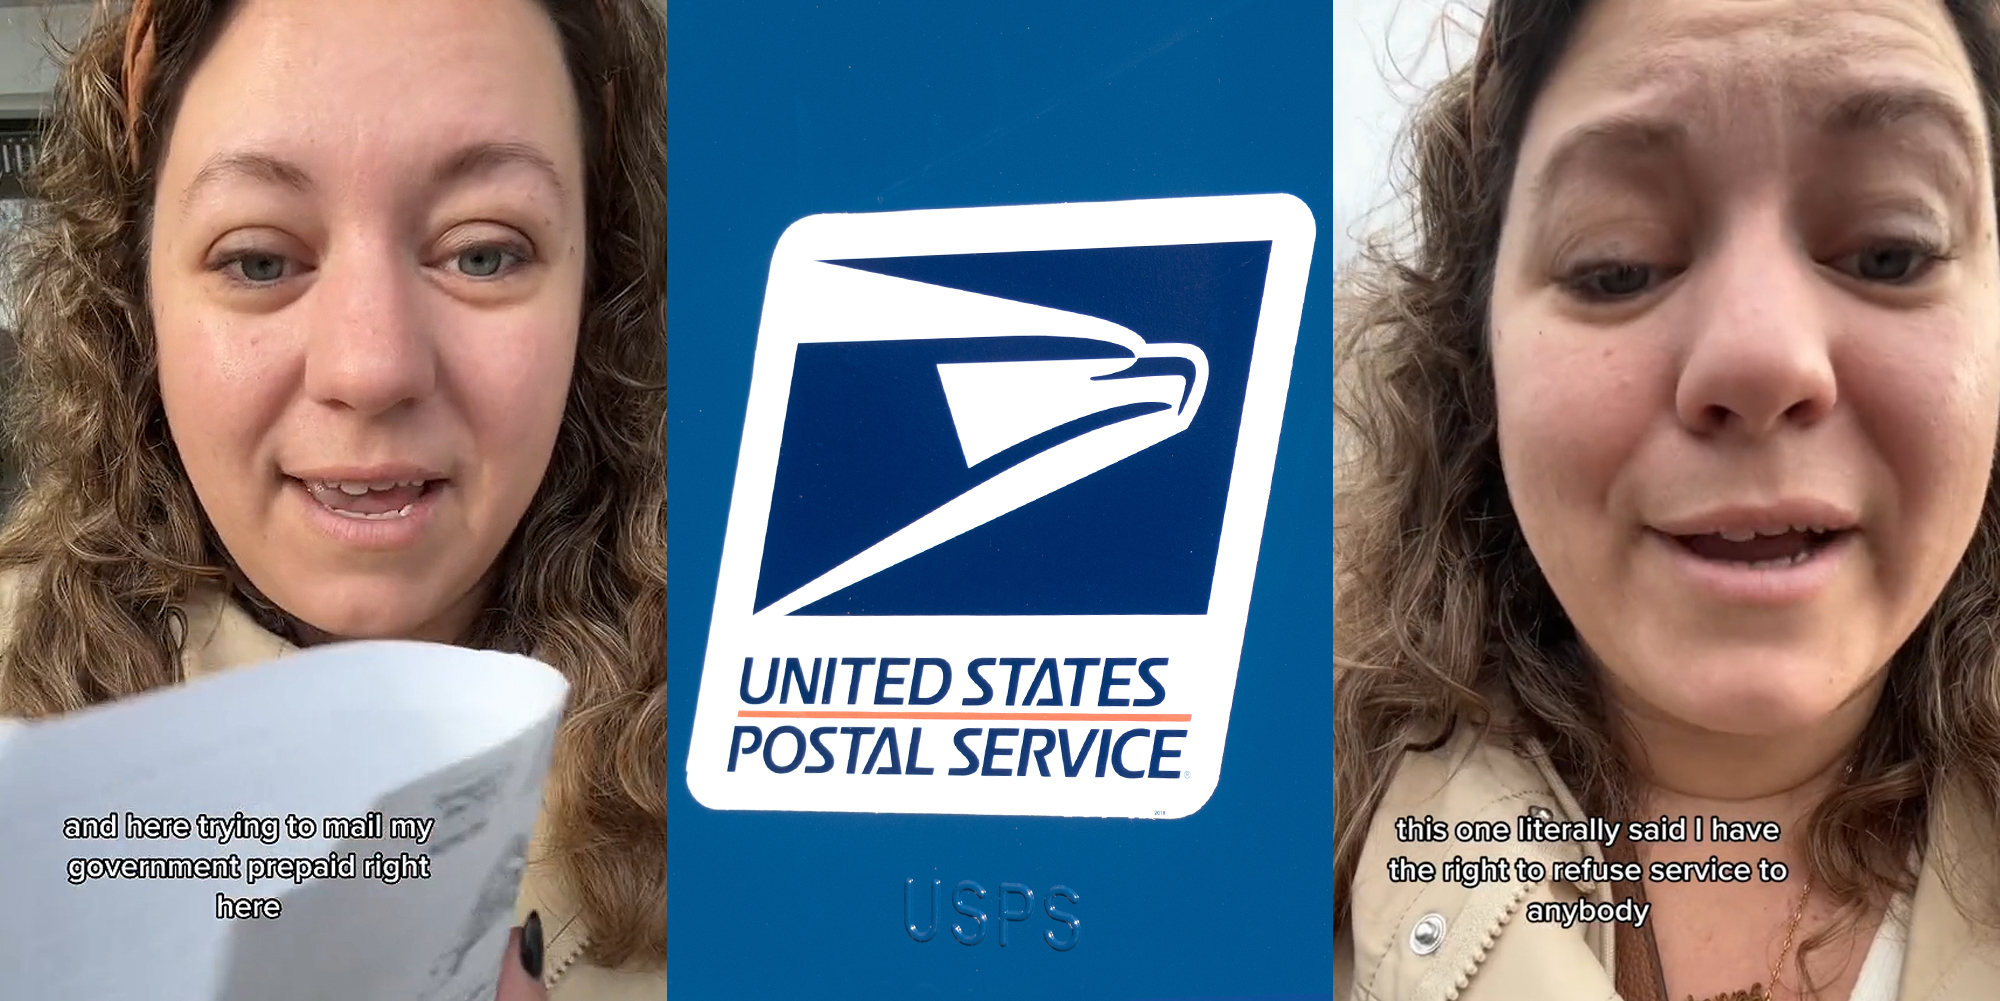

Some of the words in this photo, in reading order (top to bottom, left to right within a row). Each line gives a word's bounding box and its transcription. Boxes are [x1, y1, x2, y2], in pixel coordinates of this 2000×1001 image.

[738, 657, 953, 705] UNITED
[962, 657, 1169, 707] STATES
[727, 725, 935, 775] POSTAL
[948, 727, 1188, 779] SERVICE
[904, 877, 1081, 952] USPS
